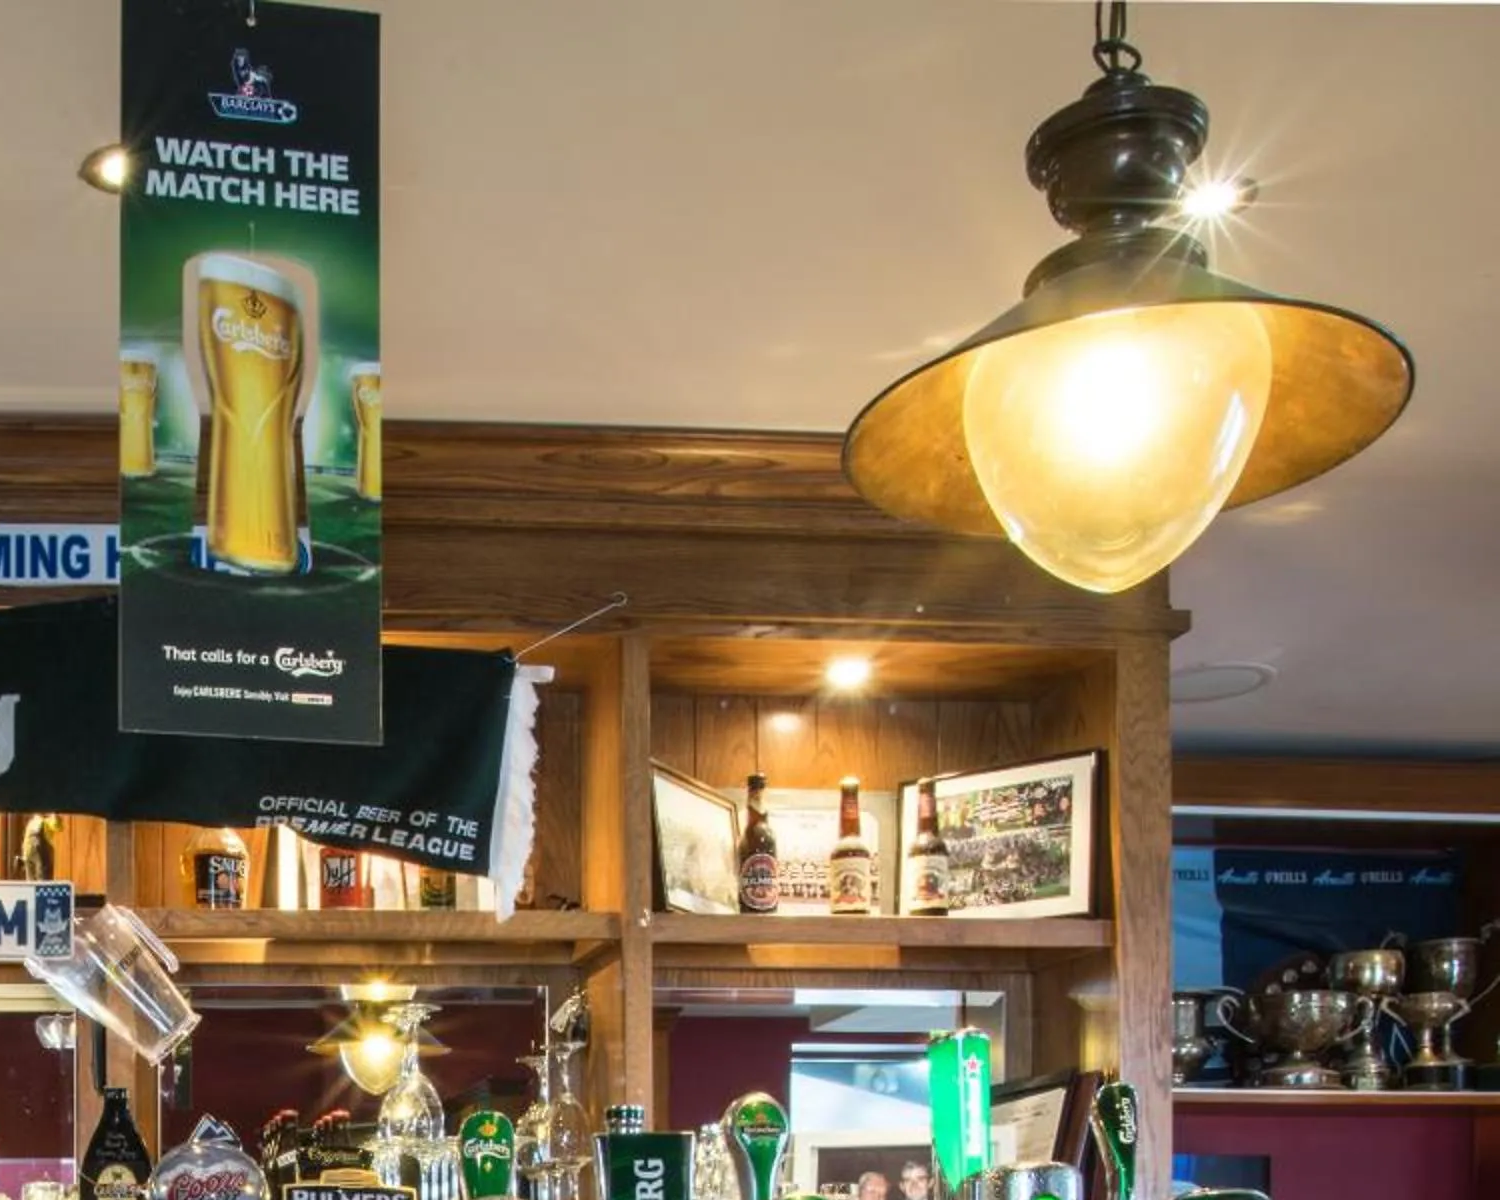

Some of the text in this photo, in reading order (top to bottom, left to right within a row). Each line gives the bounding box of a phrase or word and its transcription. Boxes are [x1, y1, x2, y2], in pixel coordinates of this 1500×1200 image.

[220, 97, 276, 114] BARCLAYS
[155, 135, 350, 182] WATCH THE
[145, 169, 361, 216] MATCH HERE
[212, 308, 292, 359] Carlsberg
[161, 645, 344, 677] That calls for a Carlsberg
[193, 685, 243, 700] CARLSBERG
[255, 815, 476, 861] PREMIER LEAGUE
[258, 795, 480, 839] OFFICIAL BEER OF THE
[462, 1138, 512, 1160] Carlsberg
